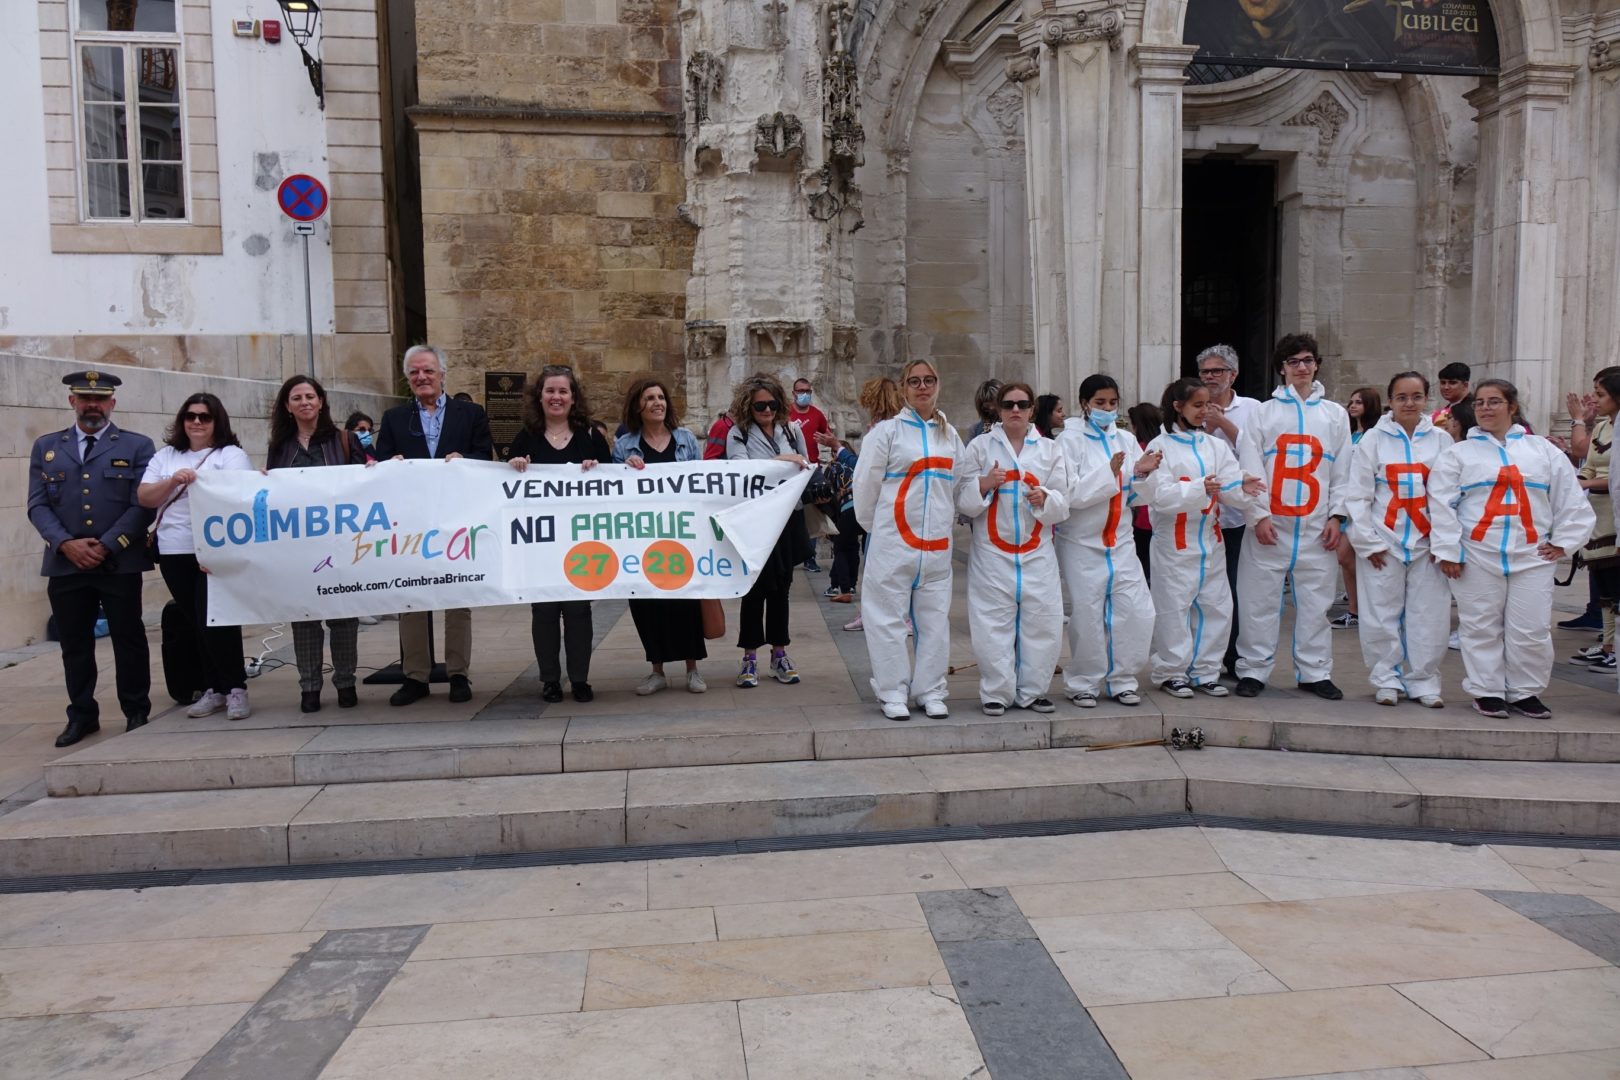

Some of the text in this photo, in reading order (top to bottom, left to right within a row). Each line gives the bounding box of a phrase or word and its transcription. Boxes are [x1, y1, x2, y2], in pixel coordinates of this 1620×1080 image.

[502, 472, 788, 499] VENHAM DIVERTIR-
[894, 456, 954, 551] C
[1270, 433, 1324, 517] B
[1470, 464, 1538, 545] A
[203, 488, 391, 548] COIMBRA
[511, 515, 555, 545] NO
[571, 511, 697, 541] PARQUE
[352, 521, 488, 565] brincar
[569, 553, 610, 577] 27
[622, 554, 640, 574] e
[646, 551, 687, 576] 28
[697, 549, 732, 577] de
[316, 572, 486, 596] facebook.com/CoimbraaBrincar
